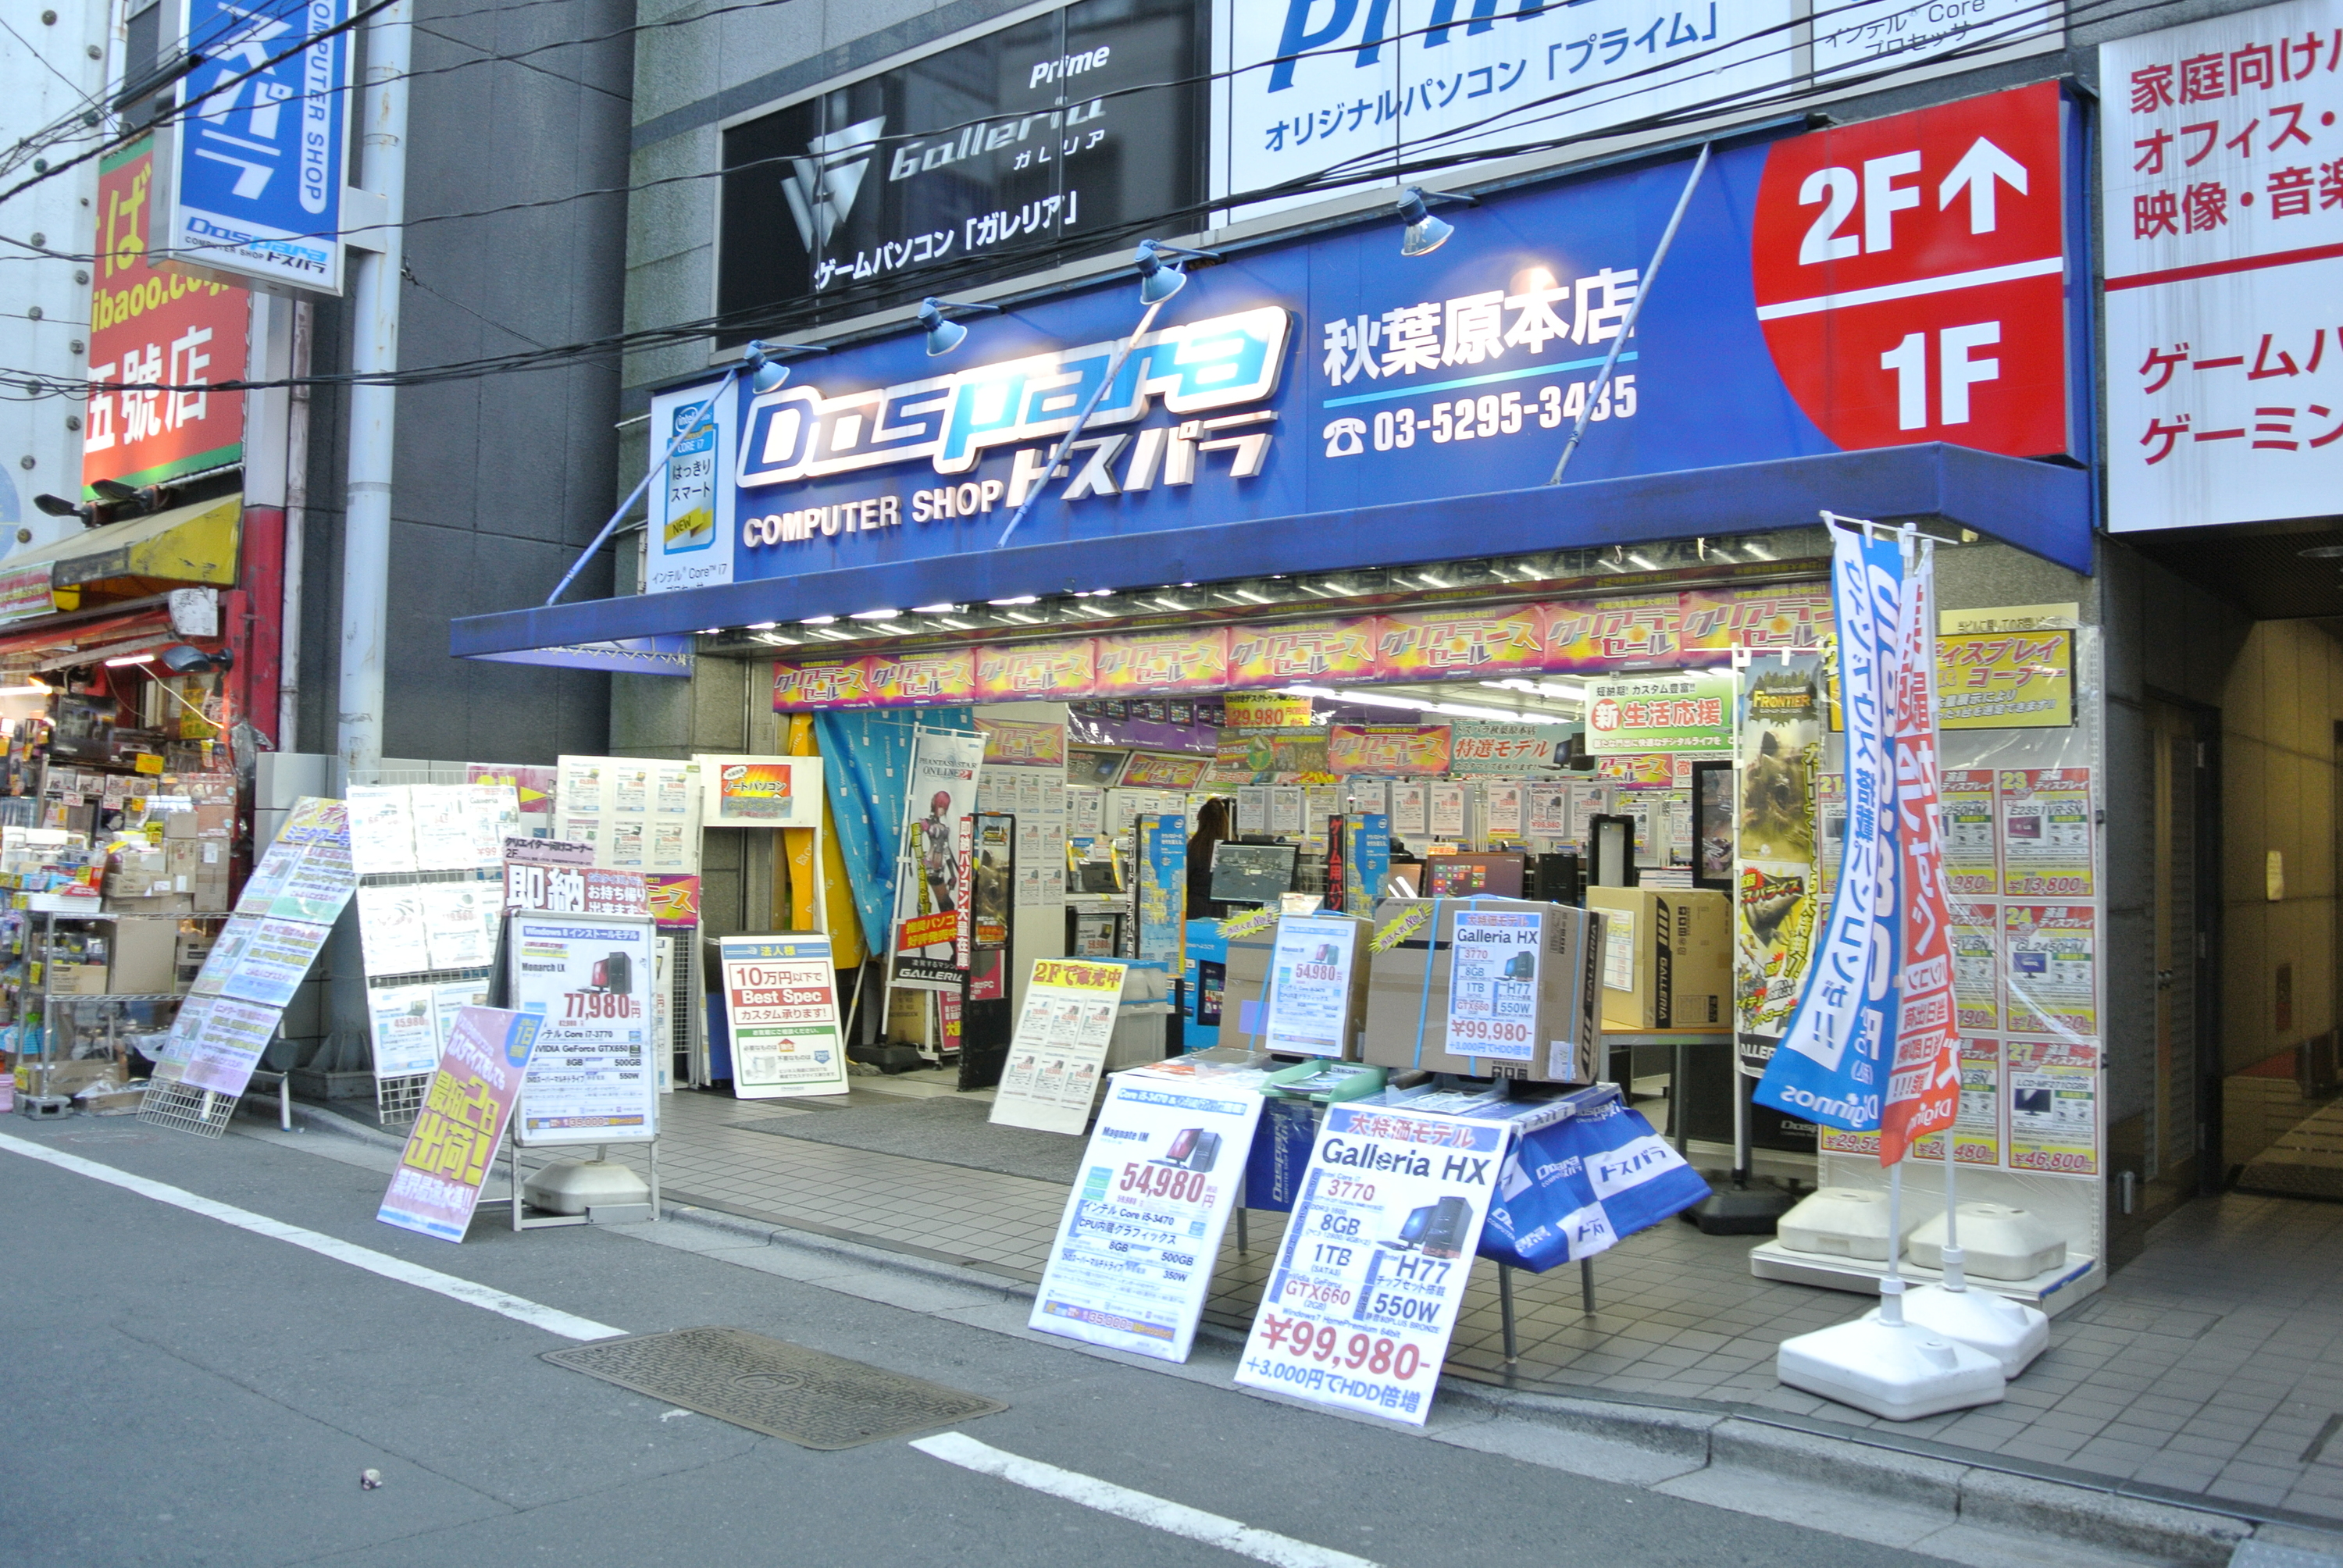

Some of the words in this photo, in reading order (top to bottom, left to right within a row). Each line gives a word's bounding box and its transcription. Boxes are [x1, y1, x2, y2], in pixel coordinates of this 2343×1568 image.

[310, 0, 331, 121] OMPUTER
[1029, 45, 1110, 89] Prime
[1264, 2, 1717, 152] オリジナルパソコン「プライム」
[1013, 129, 1106, 171] ガレリア
[305, 132, 324, 201] SHOP
[1799, 150, 1921, 266] 2F
[185, 236, 236, 254] COMPUTER
[240, 248, 264, 260] SHOP
[187, 216, 328, 262] Dospara
[266, 251, 327, 273] ドスパラ
[1324, 267, 1639, 387] 秋葉原本店
[1881, 320, 2001, 430] 1F
[736, 305, 1293, 489] Dospara
[672, 458, 711, 481] はっきり
[1005, 410, 1278, 508] ドスパラ
[671, 482, 711, 502] スマート
[744, 494, 903, 548] COMPUTER
[911, 479, 1004, 522] SHOP
[672, 515, 692, 536] NEW
[718, 563, 727, 576] i7
[1602, 633, 1675, 659] セール
[1742, 624, 1821, 648] セール
[1274, 654, 1331, 677] セール
[1428, 644, 1492, 668] セール
[1013, 672, 1058, 692] セール
[1136, 665, 1186, 685] セール
[1967, 661, 2067, 688] コーナー
[802, 679, 840, 703] セール
[902, 680, 943, 697] セール
[1752, 692, 1812, 707] FRONTIER
[1329, 734, 1450, 761] クリアランス
[1455, 739, 1550, 759] 特選モデル
[919, 757, 954, 767] PHANTASY
[1368, 752, 1412, 767] セール
[923, 766, 959, 777] ONLINE
[2001, 772, 2027, 790] 23
[724, 782, 787, 793] ノートパソコン
[2034, 781, 2089, 791] ディスプレイ
[506, 848, 518, 857] 2F
[506, 865, 585, 913] 即納
[956, 819, 972, 968] 即納パソコン大量在庫
[906, 914, 958, 935] 推奨パソコ
[1467, 915, 1528, 926] 大特価モデル
[2006, 907, 2032, 925] 24
[525, 926, 562, 936] Windows
[570, 929, 639, 939] インストールモデル
[1457, 928, 1511, 943] Galleria
[1517, 931, 1539, 944] HX
[761, 946, 796, 957] 法人様
[1464, 950, 1488, 959] 3770
[2015, 942, 2086, 952] GL2450HM
[522, 962, 555, 971] Monarch
[557, 964, 566, 972] LX
[736, 968, 822, 986] 10万円以下で
[1032, 962, 1122, 988] 2Fで販売中
[1296, 964, 1336, 981] 54,980
[1465, 967, 1485, 976] 8GB
[742, 990, 779, 1004] Best
[783, 989, 822, 1005] Spec
[1466, 983, 1485, 992] 1TB
[1507, 983, 1531, 994] H77
[1659, 957, 1668, 1020] GALLERIA
[564, 992, 629, 1021] 77,980
[741, 1008, 827, 1020] カスタム承ります!
[1457, 1001, 1489, 1011] GTX660
[1500, 1003, 1531, 1014] 550W
[585, 1030, 613, 1039] i7-3770
[2008, 1044, 2033, 1060] 27
[426, 1070, 501, 1137] 最短2日
[1101, 1126, 1136, 1141] Magnate
[1137, 1131, 1150, 1142] IM
[1347, 1113, 1475, 1148] 大特価モデル
[404, 1112, 493, 1186] 出荷!
[1322, 1138, 1429, 1178] Galleria
[1442, 1155, 1491, 1185] HX
[1599, 1146, 1667, 1182] ドスパラ
[1119, 1161, 1206, 1203] 54,980
[1328, 1179, 1375, 1202] 3770
[1082, 1200, 1117, 1216] インテル
[1119, 1207, 1139, 1220] Core
[1141, 1213, 1175, 1226] i5-3470
[1320, 1213, 1361, 1234] 8GB
[1078, 1217, 1176, 1245] CPU内蔵グラフィックス
[1108, 1241, 1129, 1253] 8GB
[1314, 1243, 1352, 1267] 1TB
[1161, 1251, 1194, 1267] 500GB
[1396, 1255, 1452, 1285] H77
[1163, 1270, 1188, 1282] 350W
[1376, 1275, 1446, 1298] チップセット搭載
[1286, 1279, 1351, 1306] GTX660
[1374, 1292, 1441, 1324] 550W
[1282, 1306, 1321, 1323] Windows7
[1322, 1315, 1378, 1335] HomePremium
[1379, 1326, 1401, 1339] 64bit
[1409, 1320, 1440, 1335] BRONZE
[1260, 1313, 1432, 1381] ¥99,980-
[1246, 1356, 1422, 1414] +3,000円でHDD倍増
